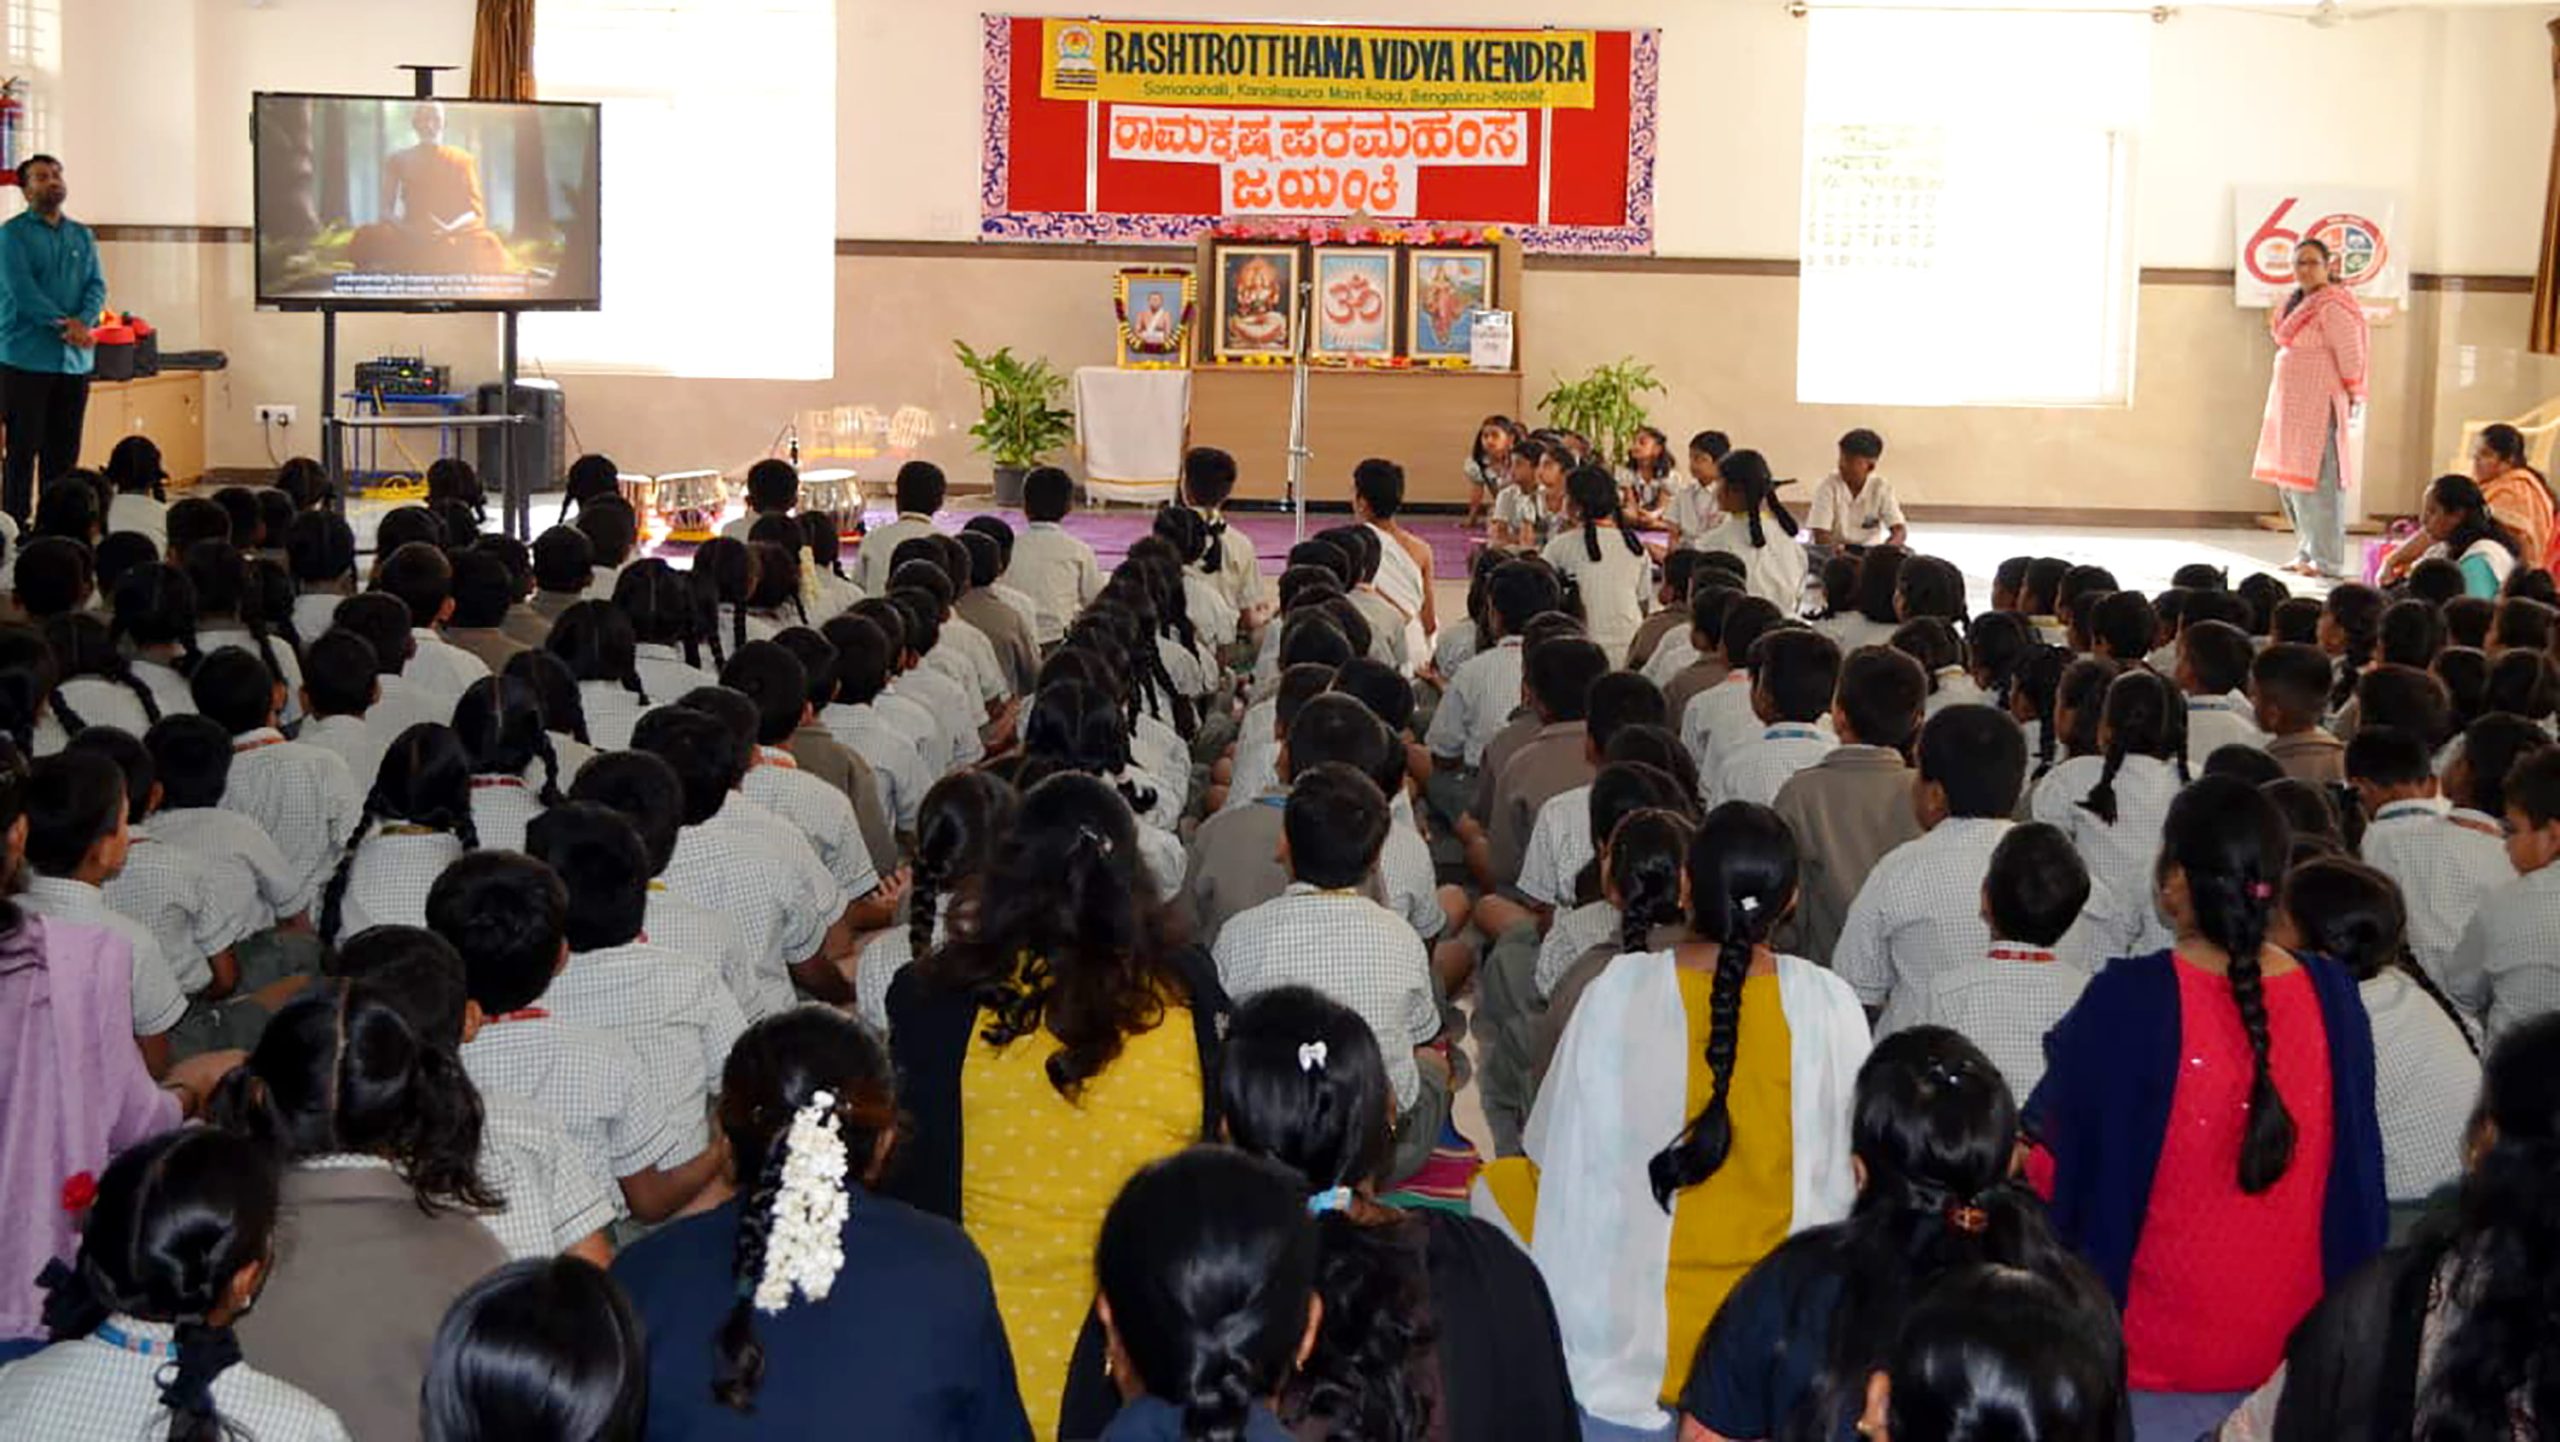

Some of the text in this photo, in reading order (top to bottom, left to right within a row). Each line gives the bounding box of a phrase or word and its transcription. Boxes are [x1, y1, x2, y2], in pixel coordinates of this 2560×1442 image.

[1105, 31, 1587, 83] RASHTROTTHANA VIDYA KENDRA
[1329, 86, 1362, 100] Main
[1115, 112, 1518, 162] ರಾಮಕೃಷ್ಣ ಪರಮಹಂಸ
[1233, 163, 1398, 211] ಜಯಂತಿ
